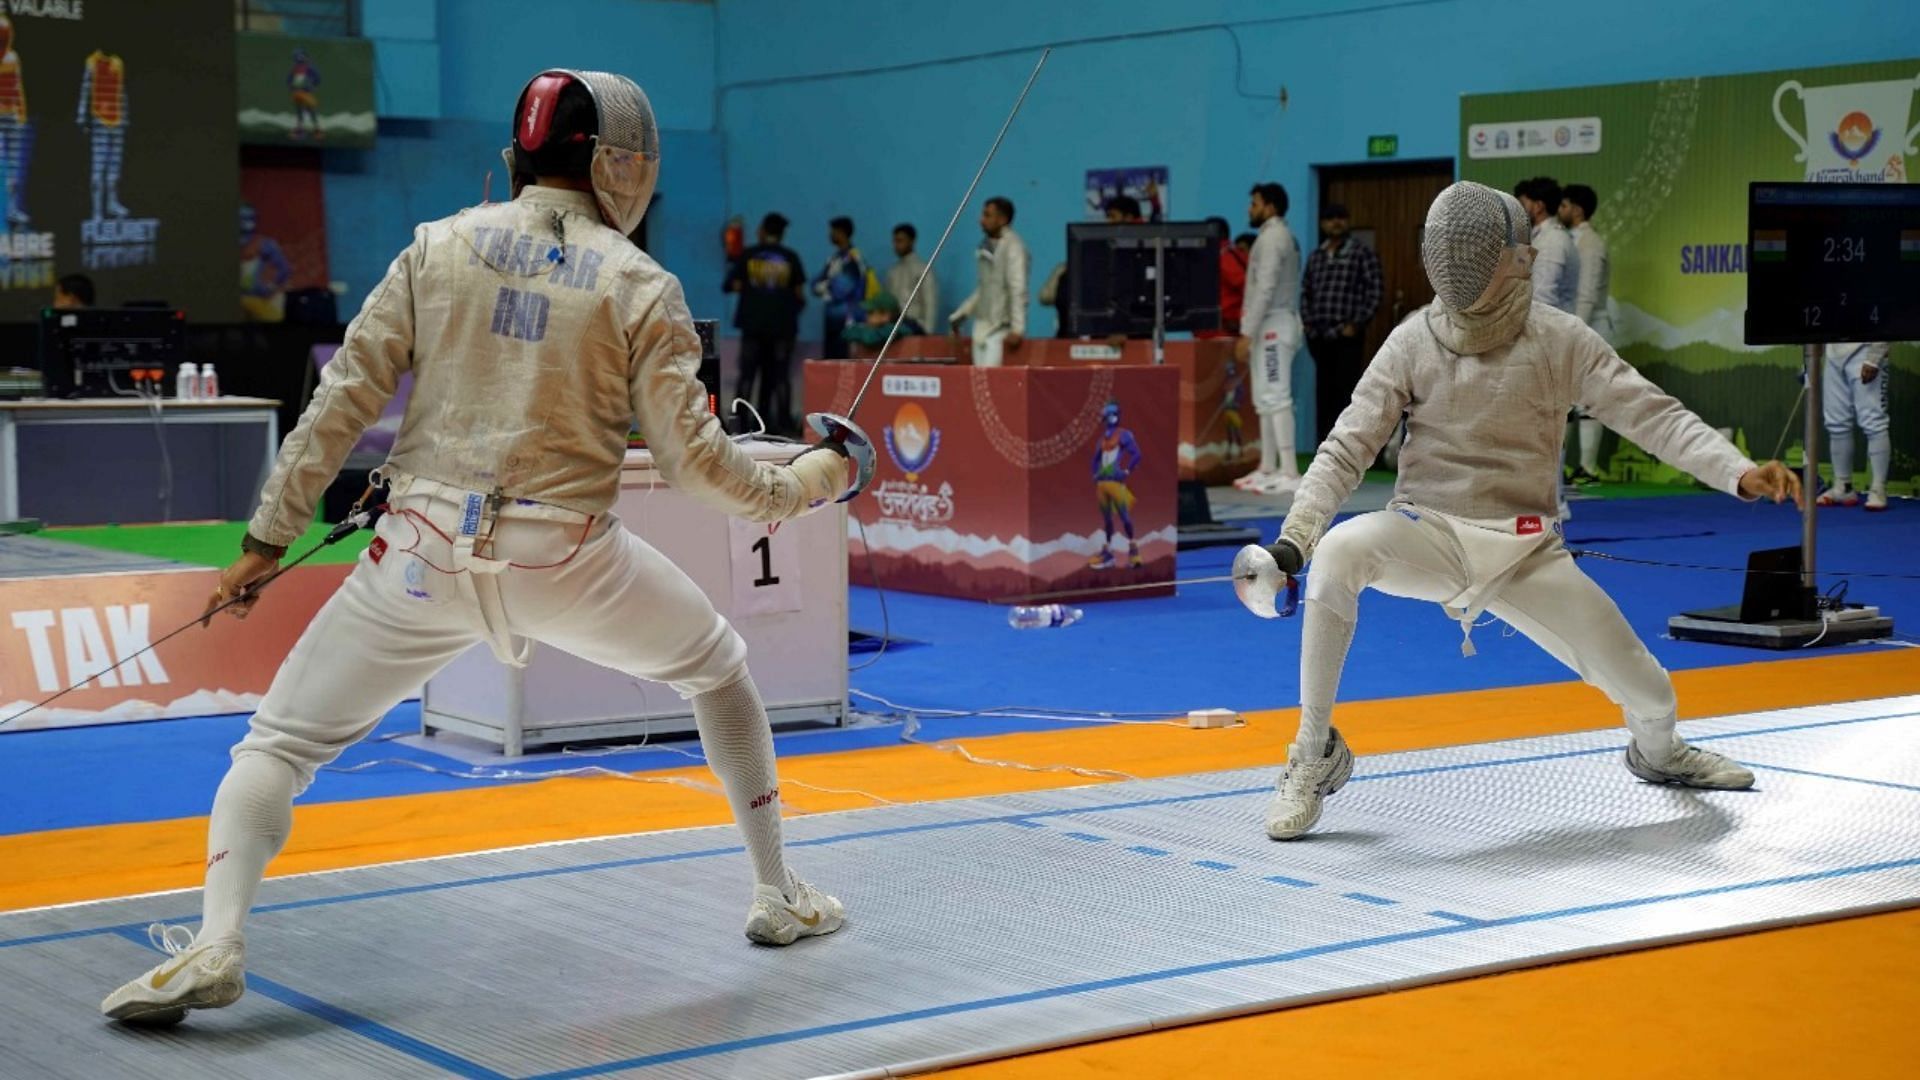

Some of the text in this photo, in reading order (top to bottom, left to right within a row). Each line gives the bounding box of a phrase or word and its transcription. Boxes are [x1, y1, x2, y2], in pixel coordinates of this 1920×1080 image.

[468, 226, 604, 291] THAPAR
[1681, 244, 1748, 274] SANKA
[1824, 237, 1866, 262] 2:34
[490, 286, 550, 343] IND
[1803, 306, 1822, 326] 12
[1870, 306, 1880, 324] 4
[751, 536, 780, 588] 1
[11, 603, 170, 693] TAK
